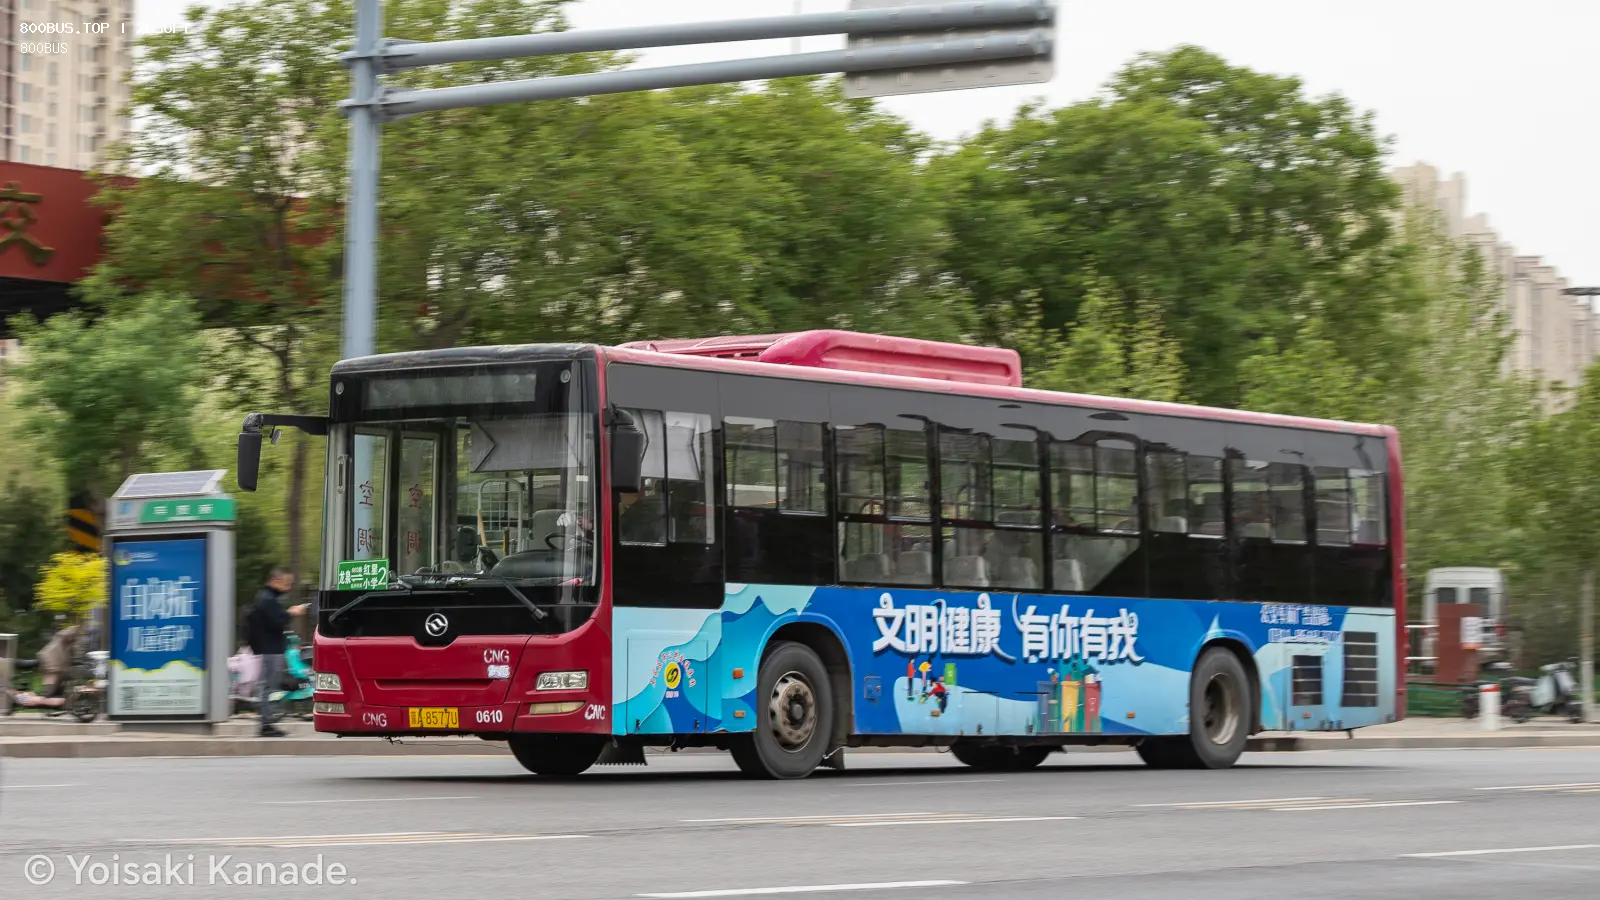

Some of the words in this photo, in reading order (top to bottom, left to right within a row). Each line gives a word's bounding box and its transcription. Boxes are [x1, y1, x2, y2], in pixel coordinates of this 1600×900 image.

[339, 570, 351, 585] 龙泉
[363, 564, 378, 576] 红星
[377, 566, 387, 586] 2
[363, 577, 378, 590] 小学
[872, 593, 1016, 660] 文明健康
[1012, 593, 1145, 663] 有你有我
[483, 648, 510, 664] CNG
[362, 712, 388, 728] CNG
[476, 709, 503, 724] 0610
